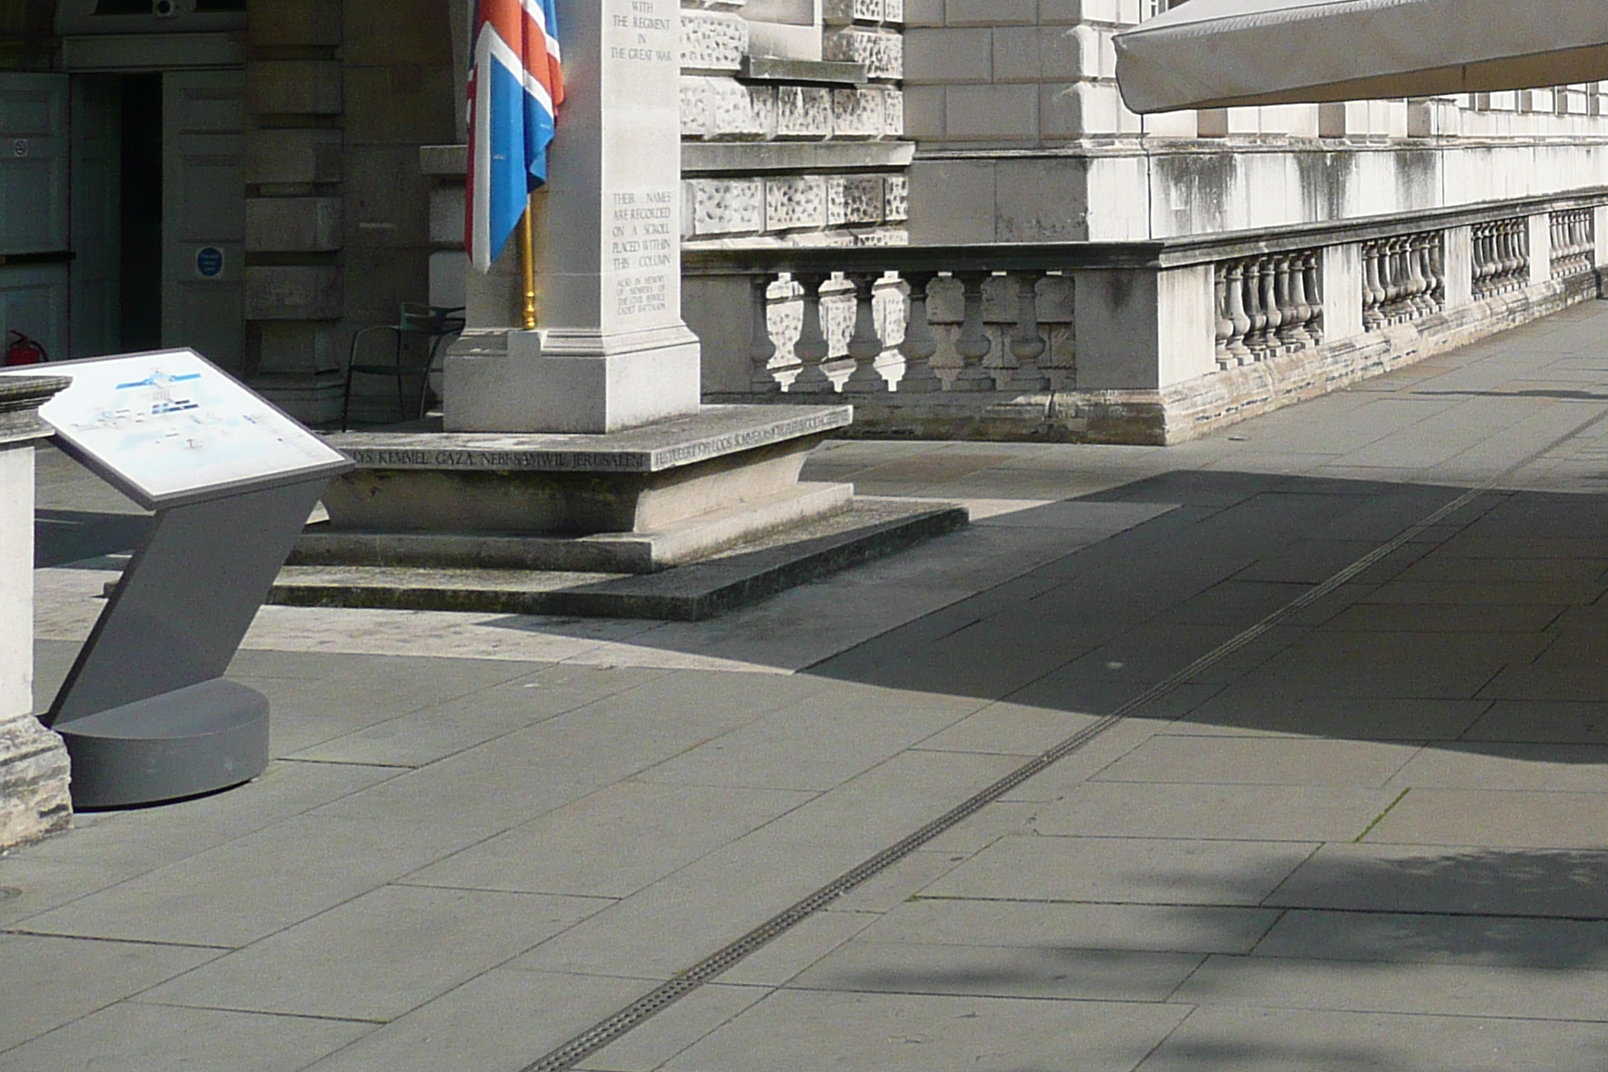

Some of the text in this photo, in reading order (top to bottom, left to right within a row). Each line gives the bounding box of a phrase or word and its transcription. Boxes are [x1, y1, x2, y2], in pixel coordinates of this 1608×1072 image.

[631, 1, 653, 13] WITH
[613, 14, 671, 31] THE REGIMENT
[638, 33, 646, 44] IN
[610, 46, 672, 61] THE GREAT WAR
[613, 191, 671, 205] THEIR NAMES
[613, 207, 671, 221] ARE RECORDED
[612, 226, 624, 237] ON
[643, 223, 670, 235] SCROLL
[612, 239, 671, 253] PLACED WITHIN
[612, 254, 671, 270] THIS COLUMN
